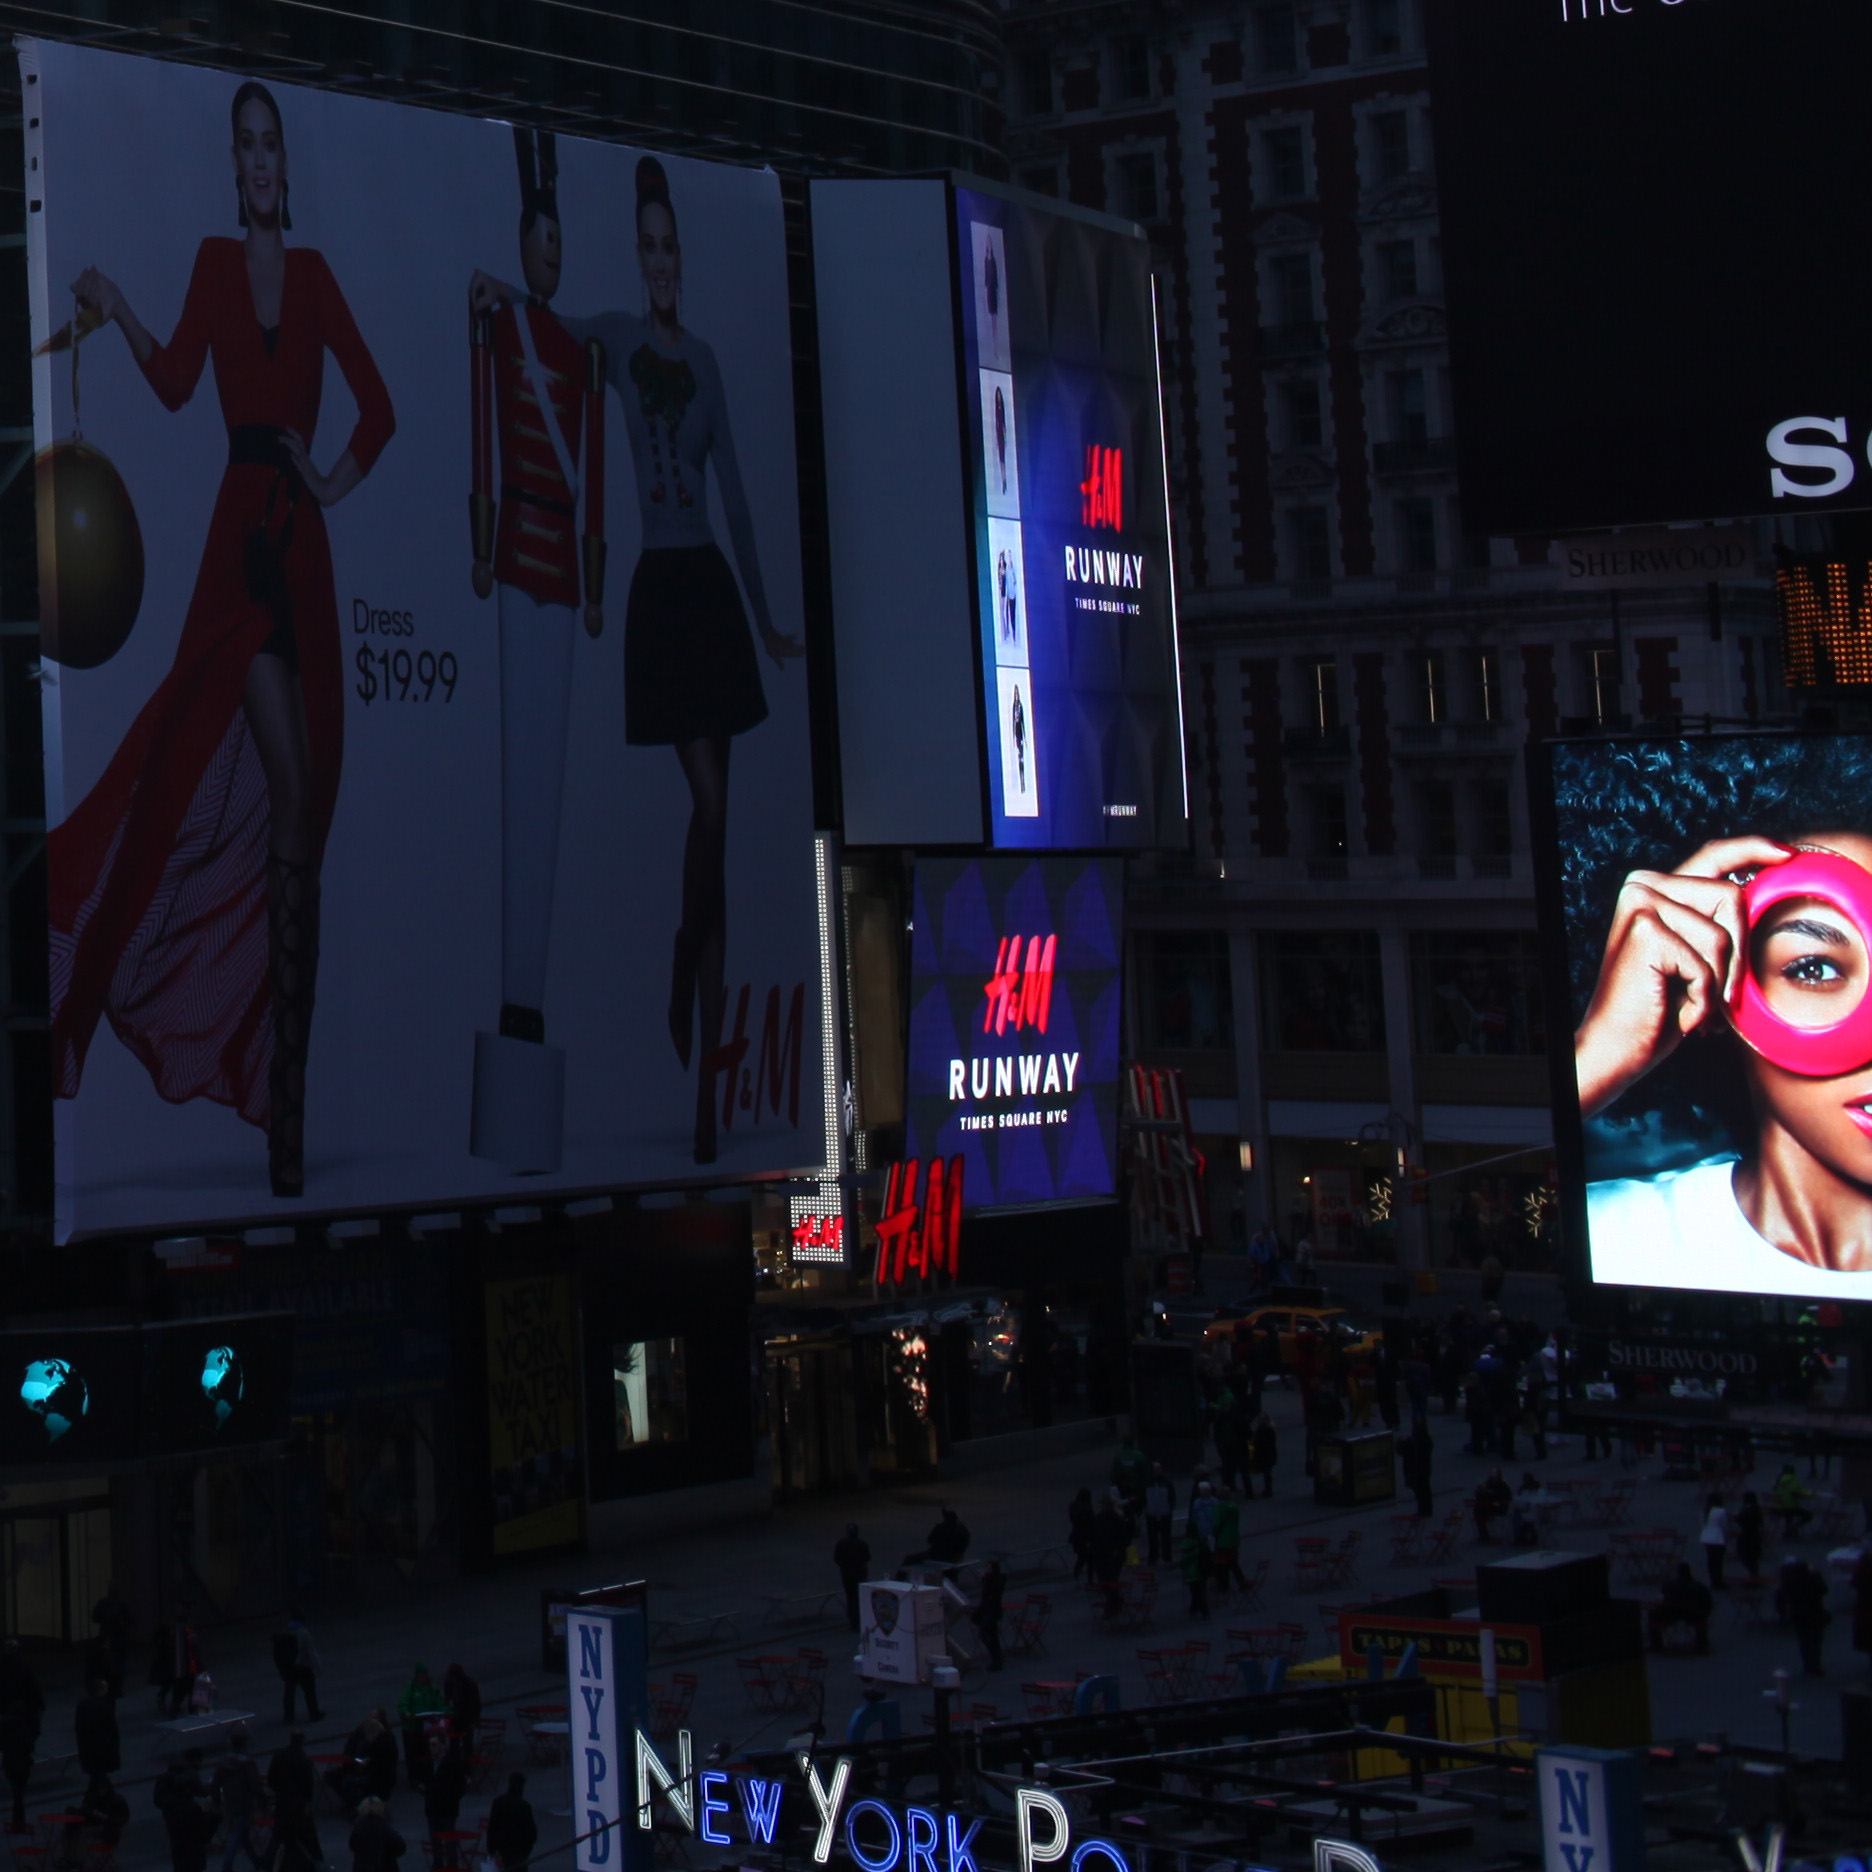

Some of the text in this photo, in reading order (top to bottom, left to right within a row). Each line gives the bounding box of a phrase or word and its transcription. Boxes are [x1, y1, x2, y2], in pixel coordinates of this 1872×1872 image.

[1079, 443, 1122, 534] H&M
[1064, 545, 1143, 589] RUNWAY
[1568, 541, 1746, 578] SHERWOOD
[353, 597, 414, 637] Dress
[355, 640, 458, 707] $19.99
[984, 933, 1058, 1037] H&M
[703, 983, 805, 1129] H&M
[949, 1052, 1080, 1101] RUNWAY
[960, 1108, 1068, 1131] TIMES SQUARE NYC
[792, 1215, 845, 1251] H&M
[875, 1153, 964, 1286] H&M
[1446, 1640, 1523, 1660] PAAS
[579, 1625, 610, 1864] NYPD
[634, 1728, 784, 1845] NEW
[795, 1749, 985, 1872] YORK
